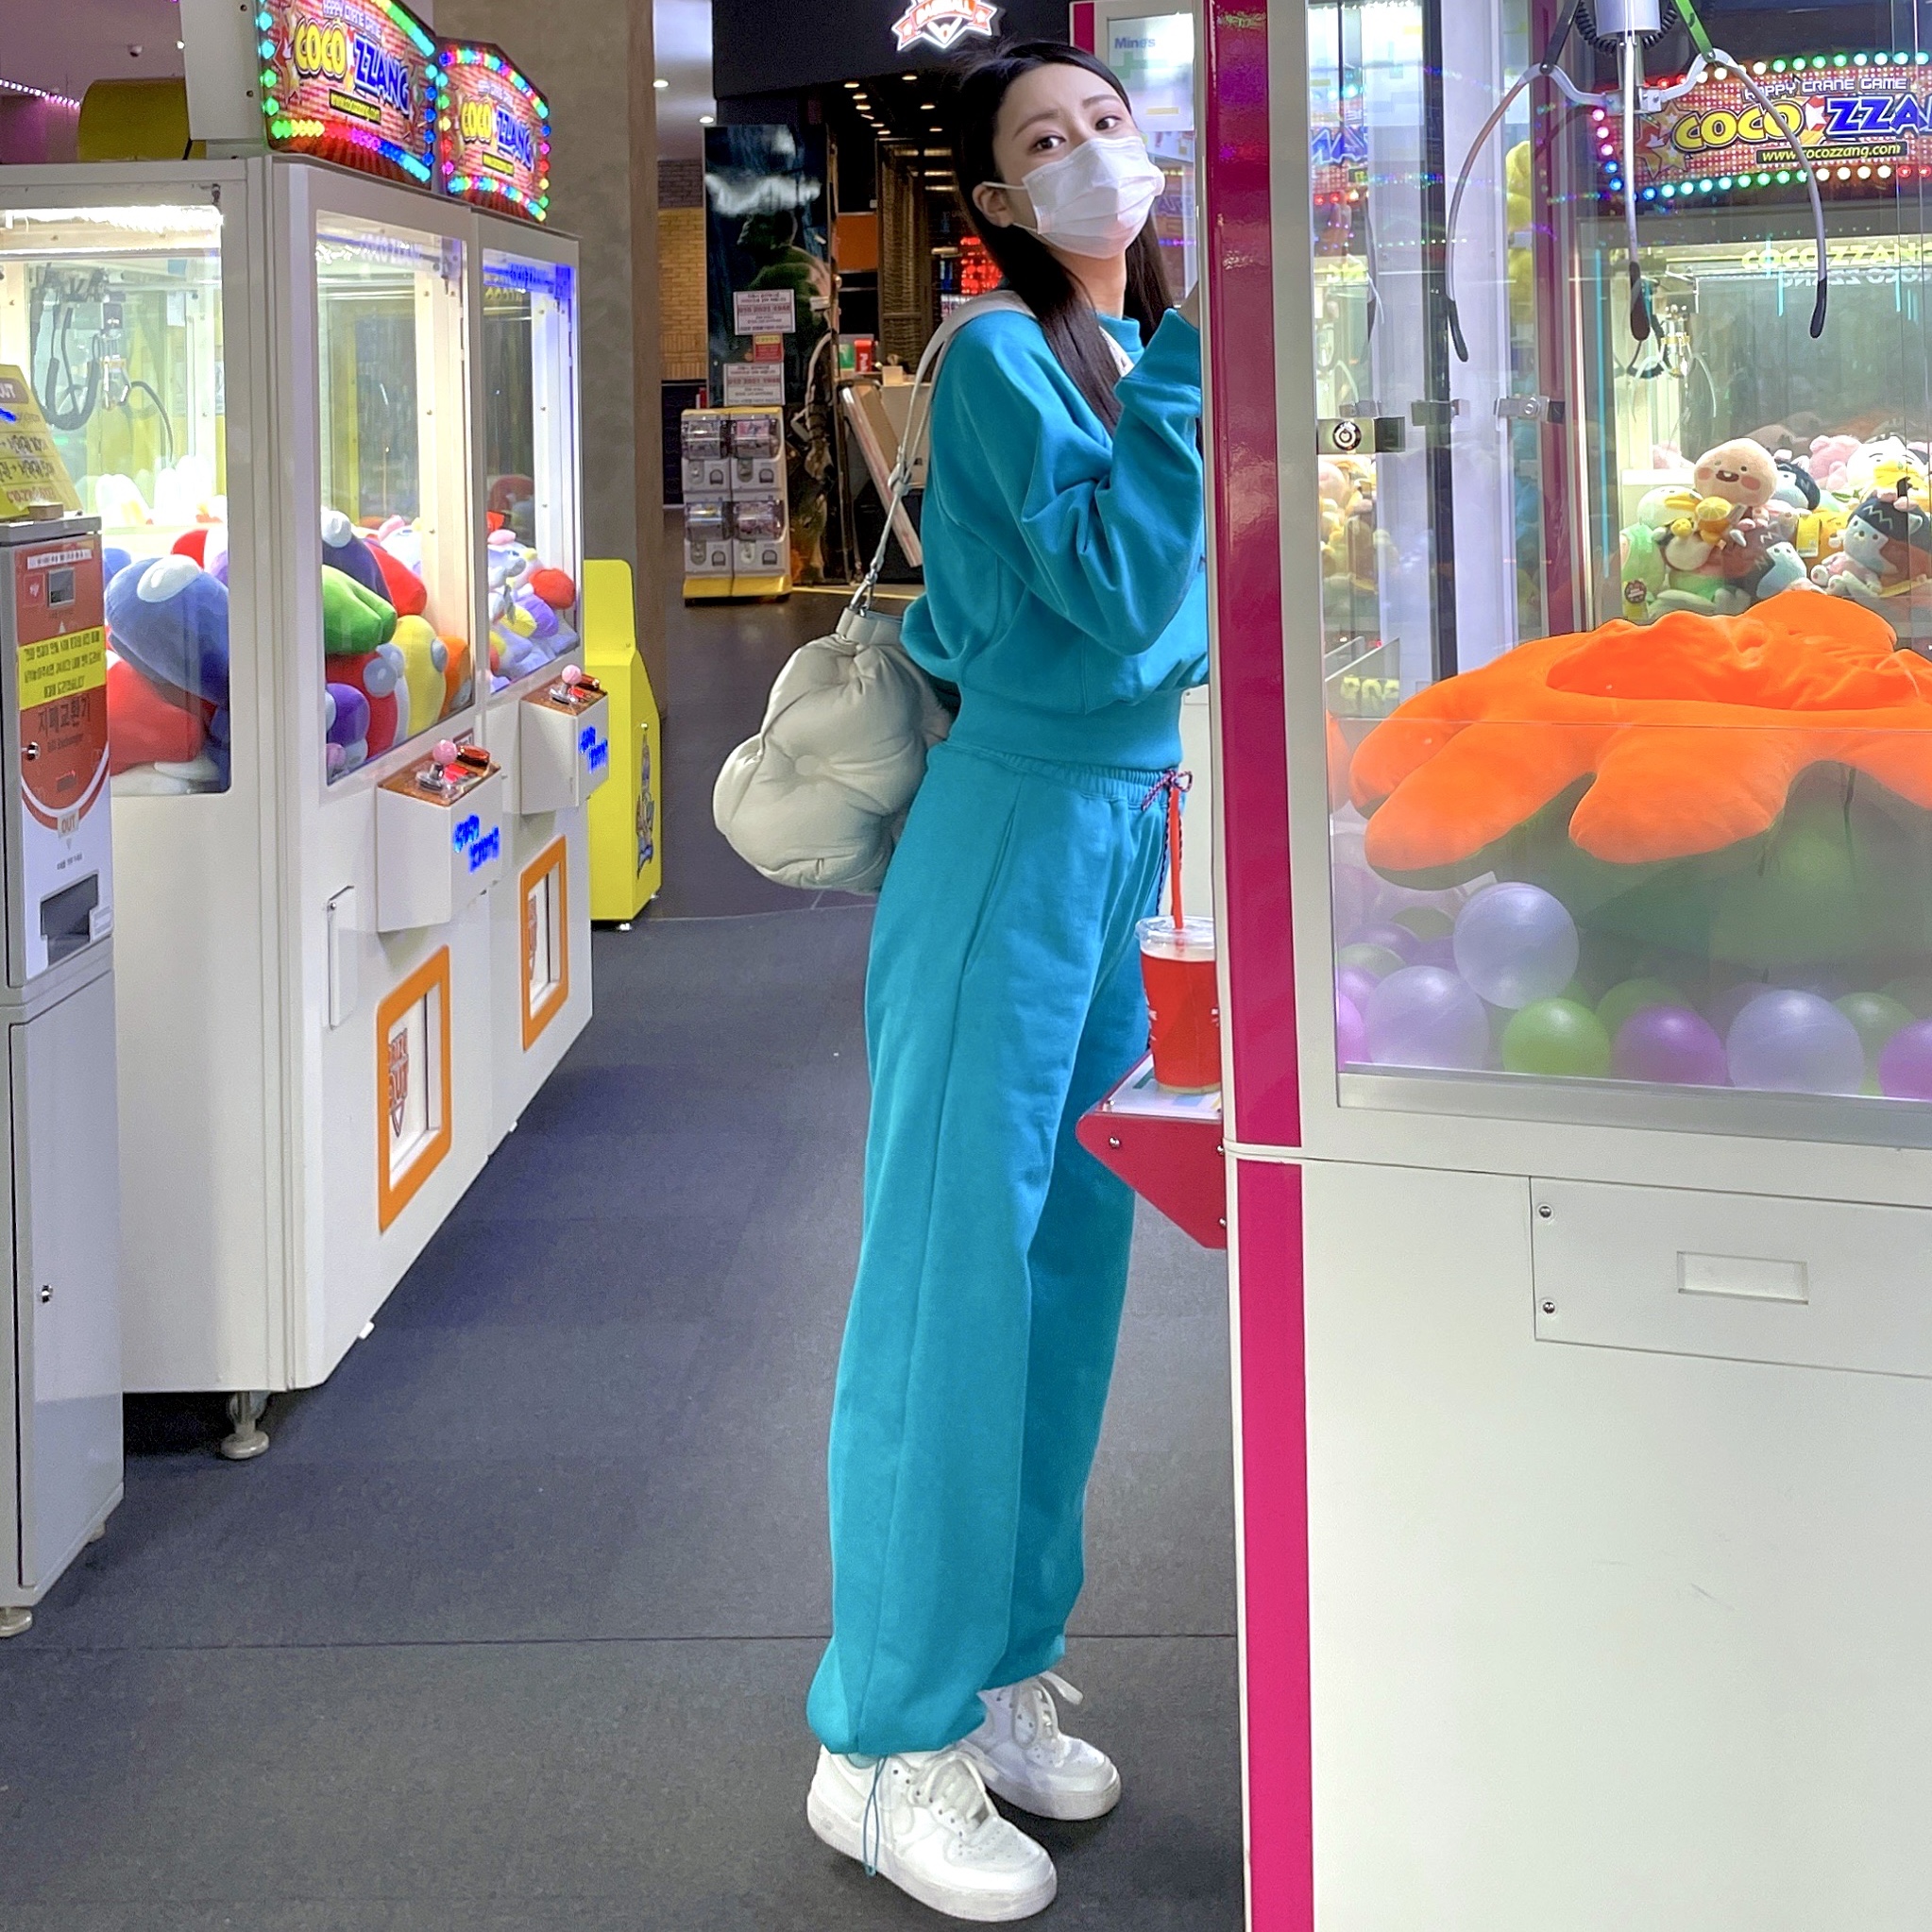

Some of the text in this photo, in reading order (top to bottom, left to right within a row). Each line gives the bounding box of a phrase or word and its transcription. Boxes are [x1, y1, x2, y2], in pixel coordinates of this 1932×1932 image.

[294, 23, 347, 79] COCO
[353, 35, 412, 115] ZZANG
[1802, 77, 1855, 93] CRANE
[1860, 77, 1907, 91] GAME
[461, 101, 492, 143] COCO
[1674, 93, 1932, 149] COCO ZZA
[1762, 143, 1902, 163] wwwocozzang.com
[61, 819, 76, 835] OUT
